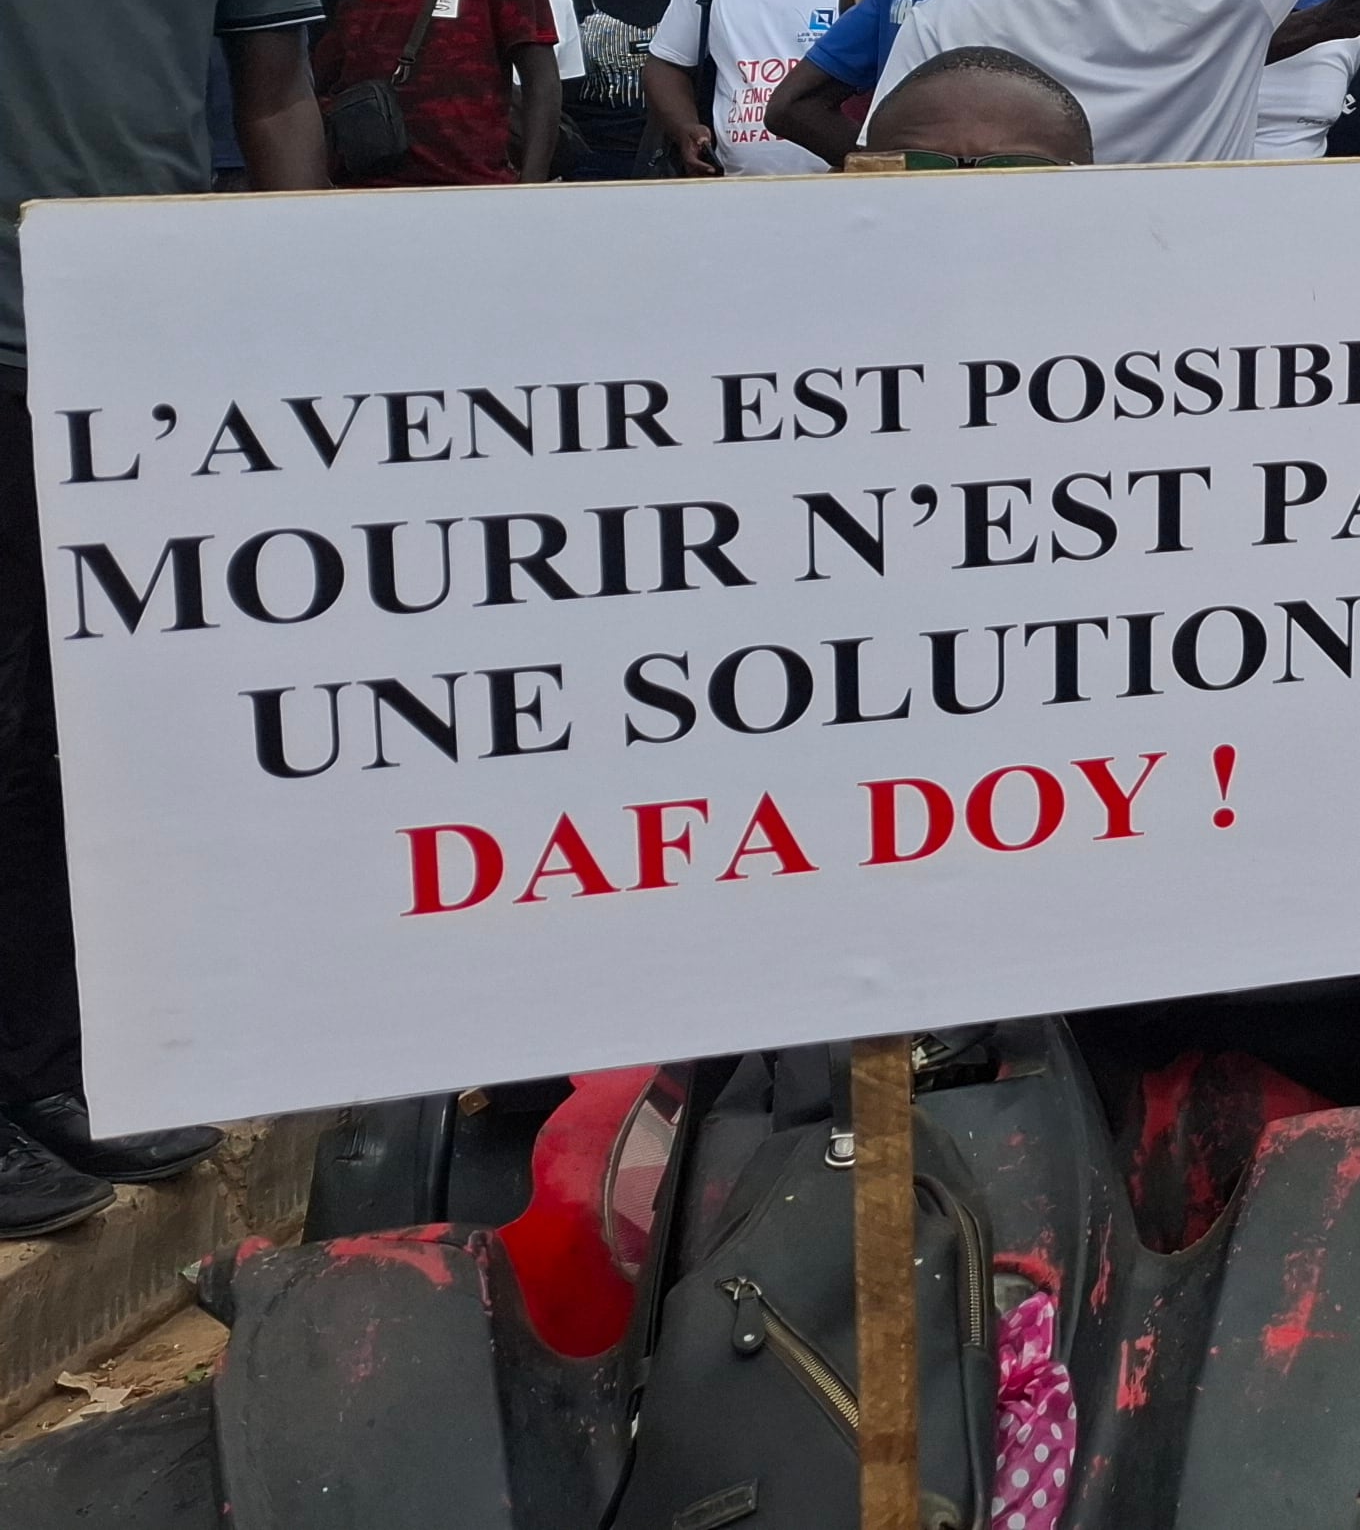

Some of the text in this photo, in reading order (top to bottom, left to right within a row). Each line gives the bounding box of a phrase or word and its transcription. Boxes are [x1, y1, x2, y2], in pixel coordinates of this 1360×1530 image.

[55, 379, 682, 484] L'AVENIR
[711, 364, 924, 444] EST
[57, 500, 758, 640] MOURIR
[792, 467, 1212, 581] N'EST
[239, 664, 572, 779] UNE
[396, 743, 1237, 917] DAFA DOY !
